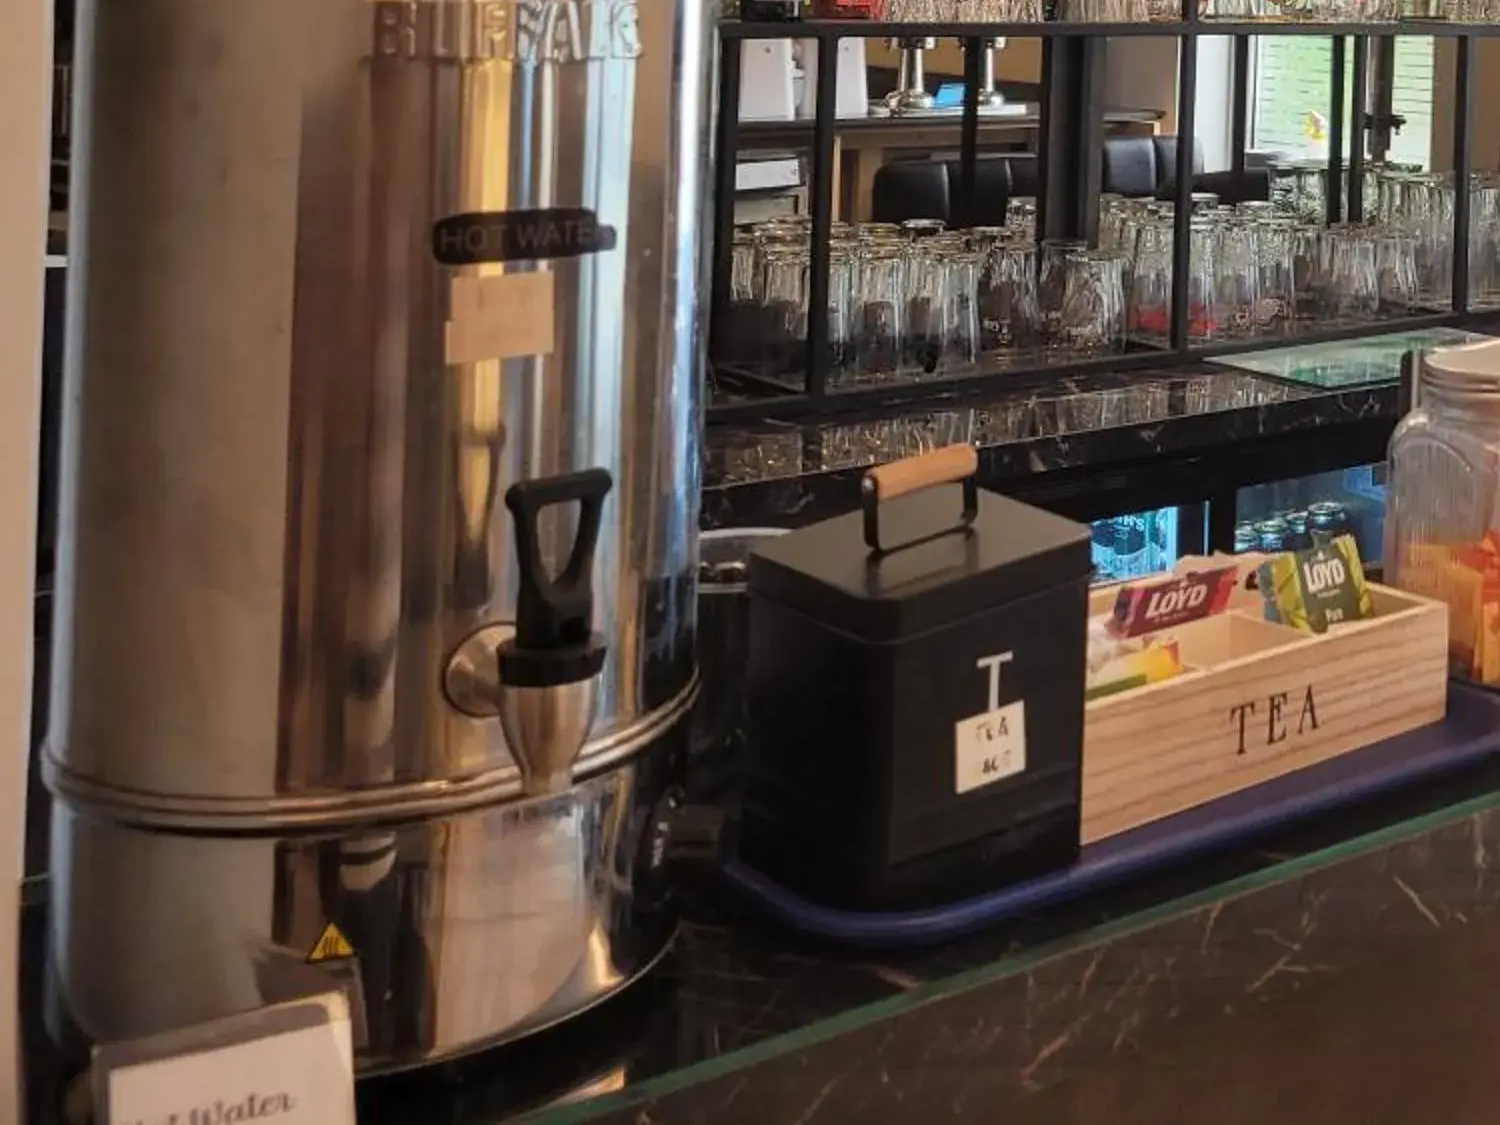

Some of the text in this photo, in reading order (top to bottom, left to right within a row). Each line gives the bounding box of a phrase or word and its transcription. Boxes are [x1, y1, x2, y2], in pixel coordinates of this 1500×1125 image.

[440, 220, 612, 253] HOT WATE
[1303, 559, 1345, 594] LOYD
[1145, 584, 1208, 619] LOYD
[1230, 684, 1320, 755] TEA
